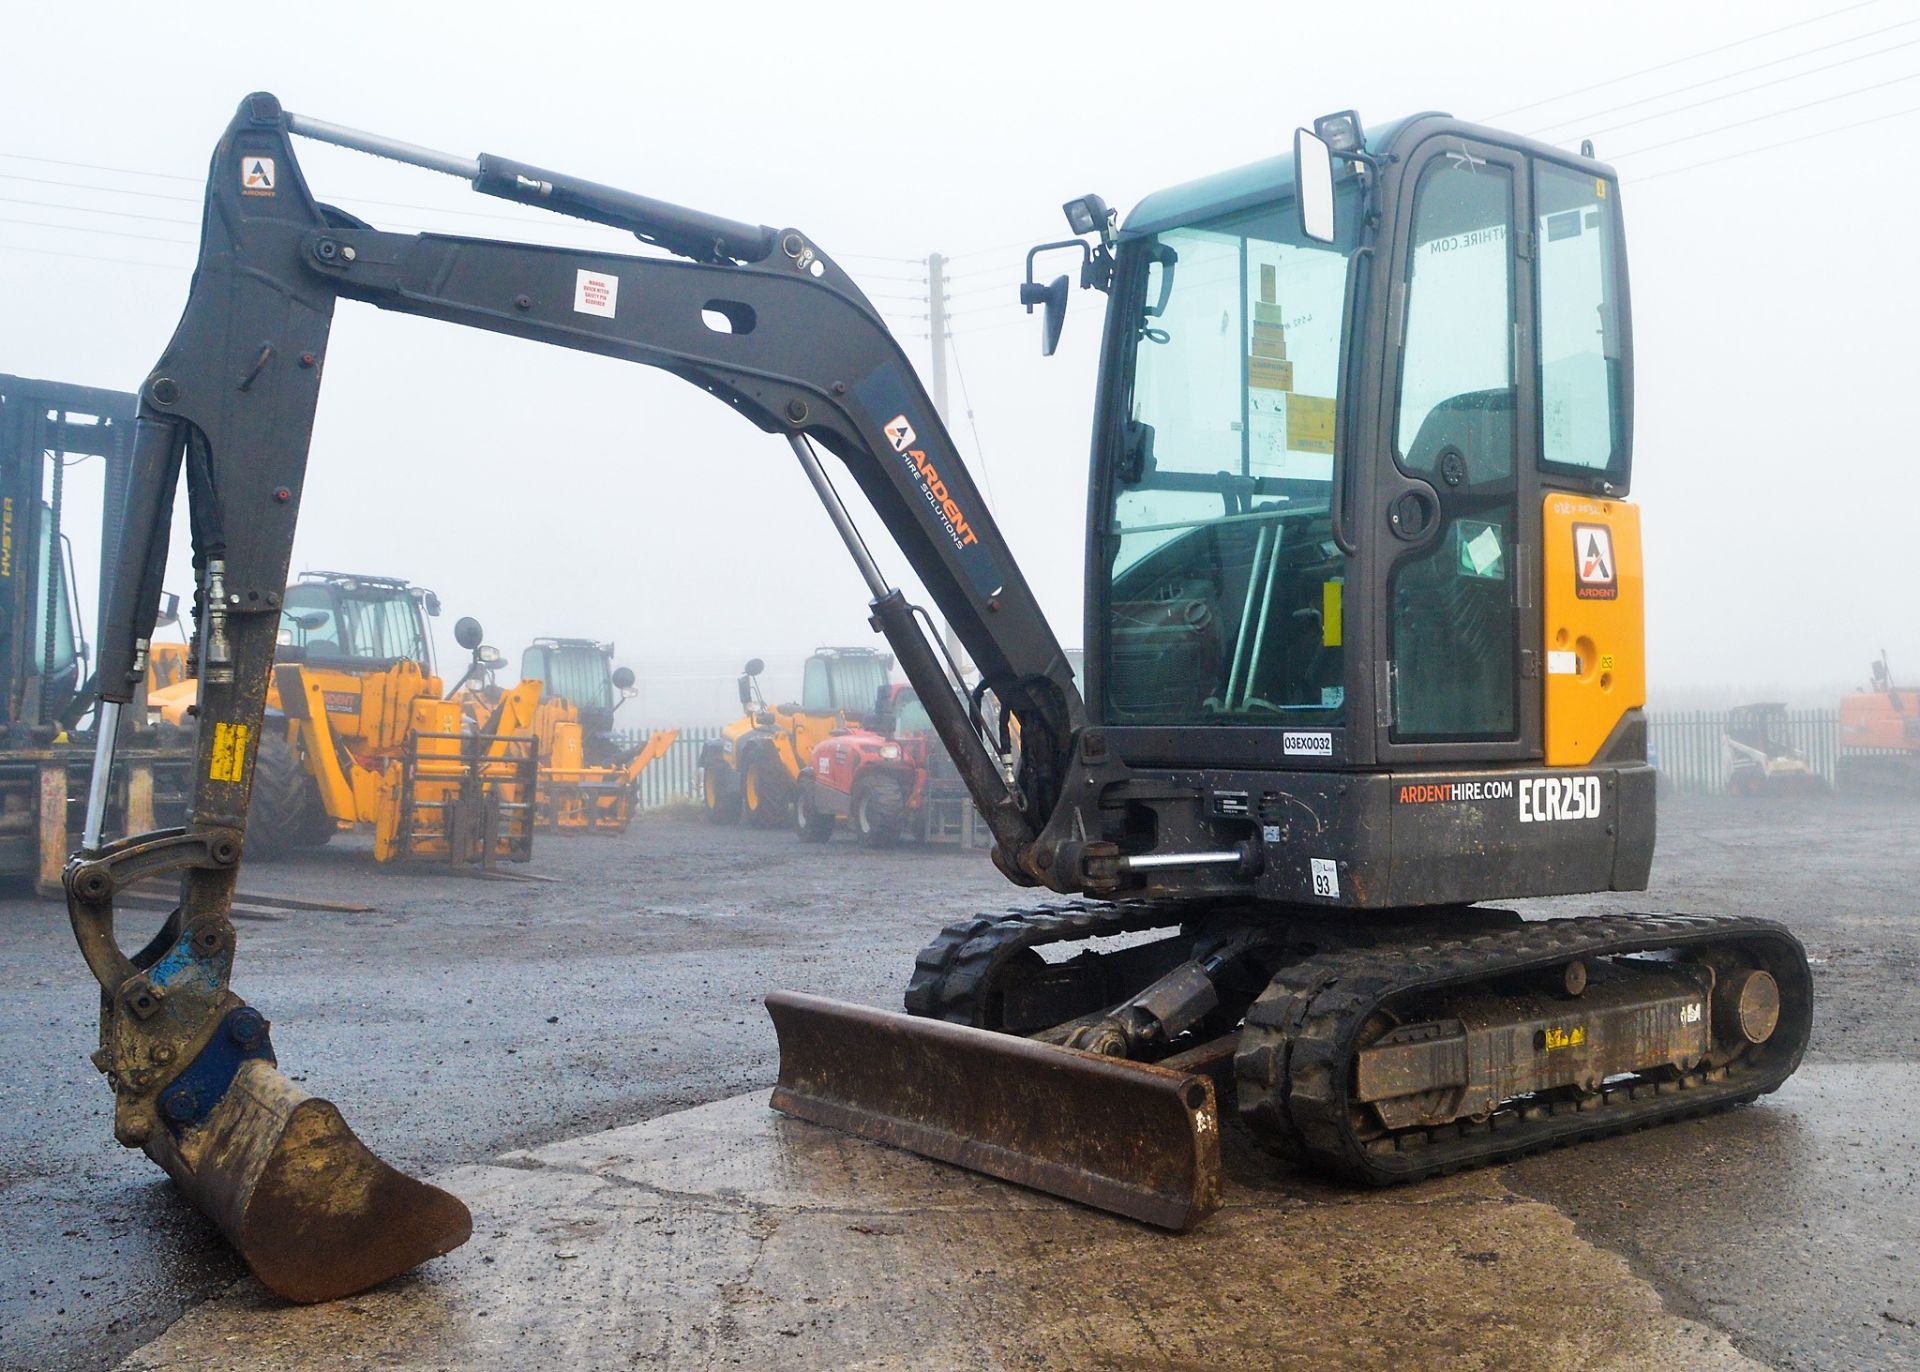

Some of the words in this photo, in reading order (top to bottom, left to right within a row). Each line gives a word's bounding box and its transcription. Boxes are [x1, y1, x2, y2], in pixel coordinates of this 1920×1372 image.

[901, 452, 921, 480] HIRE
[920, 483, 963, 550] SOLUTIONS
[908, 450, 979, 545] ARDENT
[1, 497, 13, 576] HYSTER
[1578, 588, 1616, 598] ARDENT
[1285, 736, 1331, 750] 03EX0032
[1400, 781, 1513, 803] ARDENTHIRE.COM
[1519, 776, 1600, 823] ECR25D
[1316, 874, 1330, 895] 93
